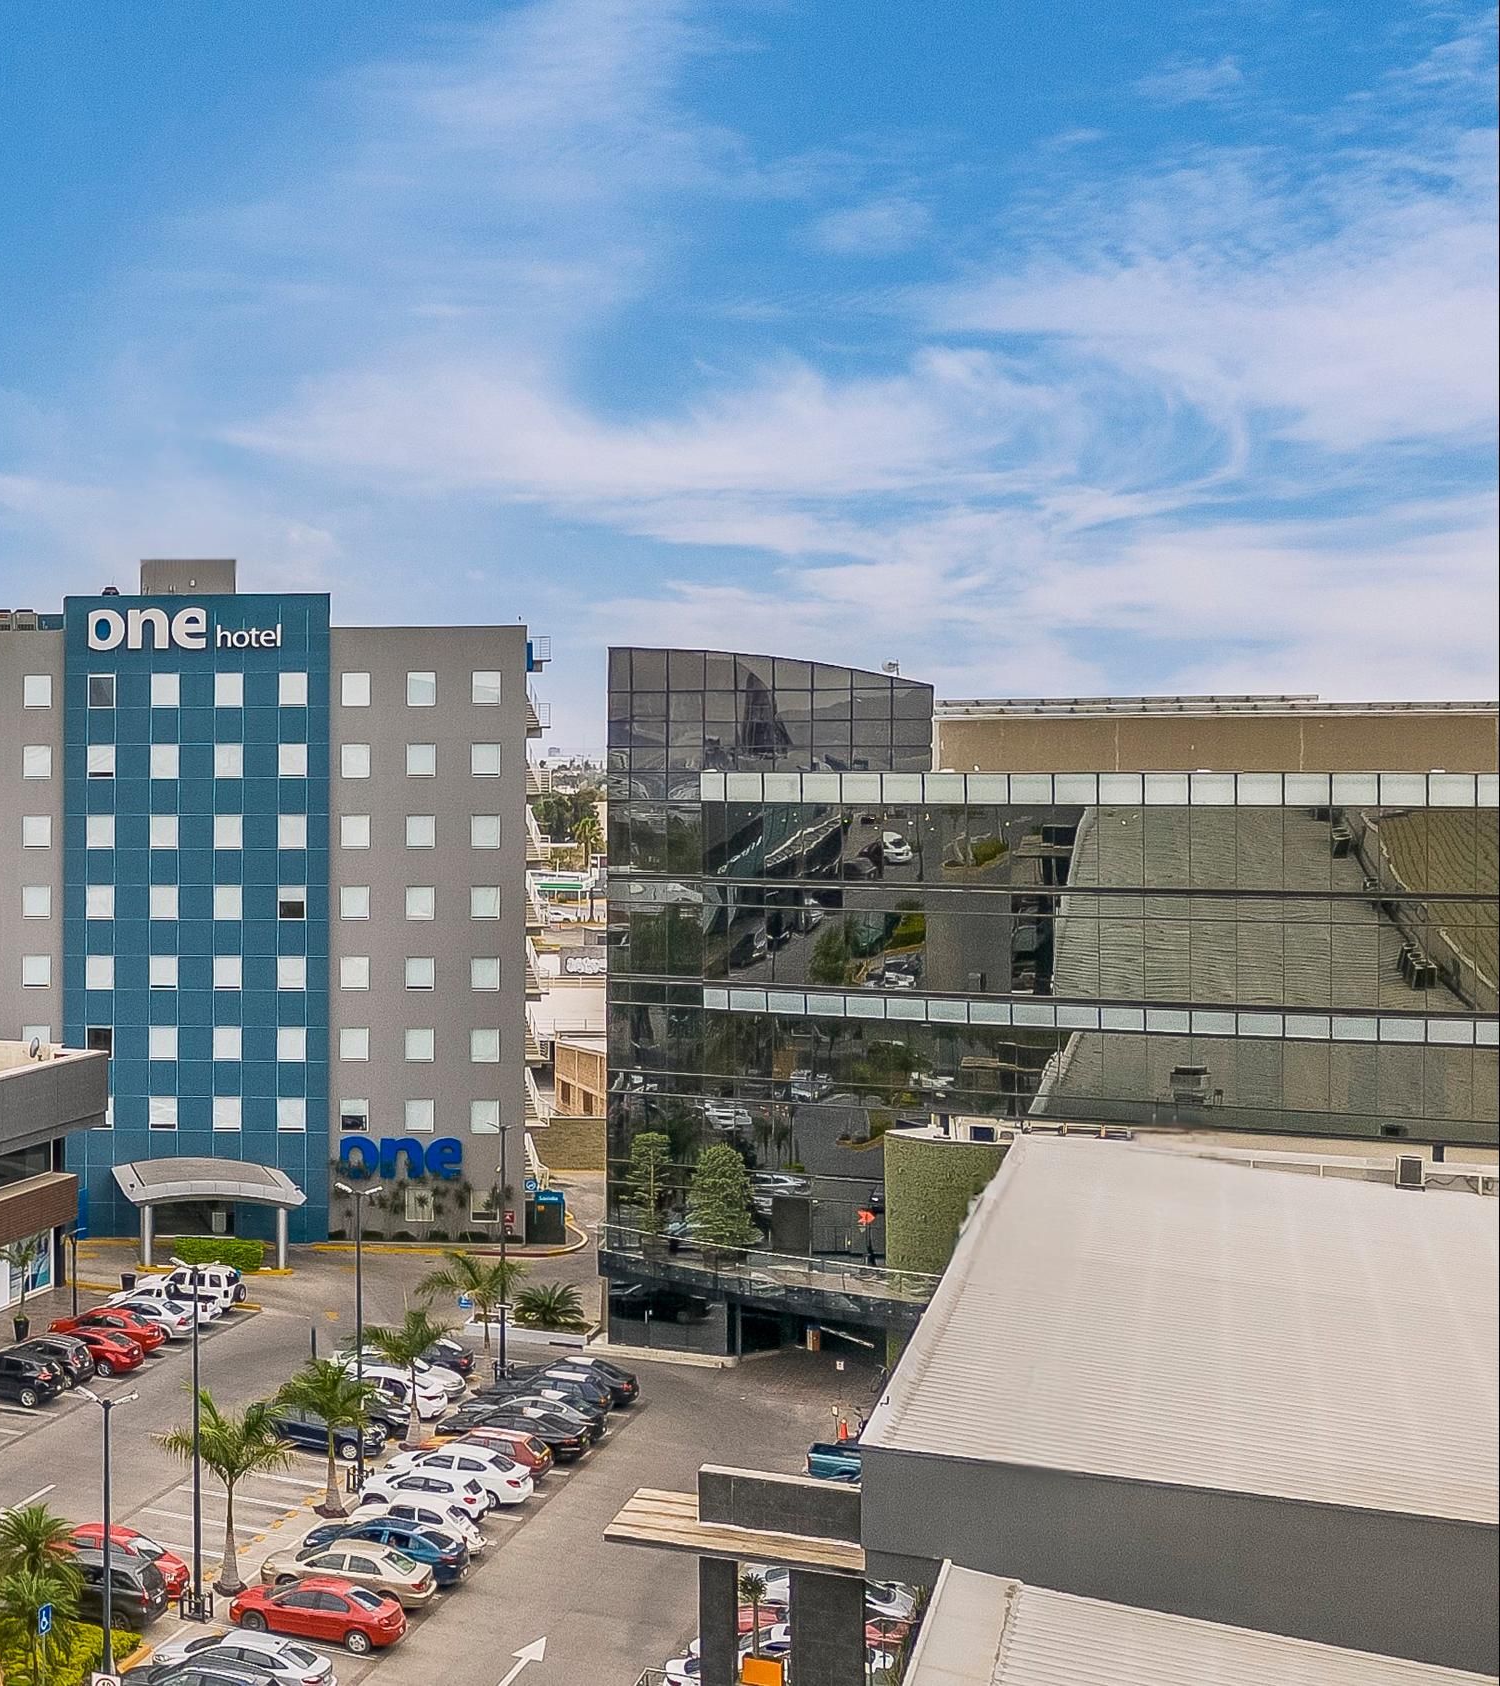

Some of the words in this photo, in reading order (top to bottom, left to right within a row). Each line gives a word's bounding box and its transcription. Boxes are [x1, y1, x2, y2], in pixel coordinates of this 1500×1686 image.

[88, 607, 206, 650] one
[216, 623, 281, 648] hotel
[339, 1136, 462, 1179] one
